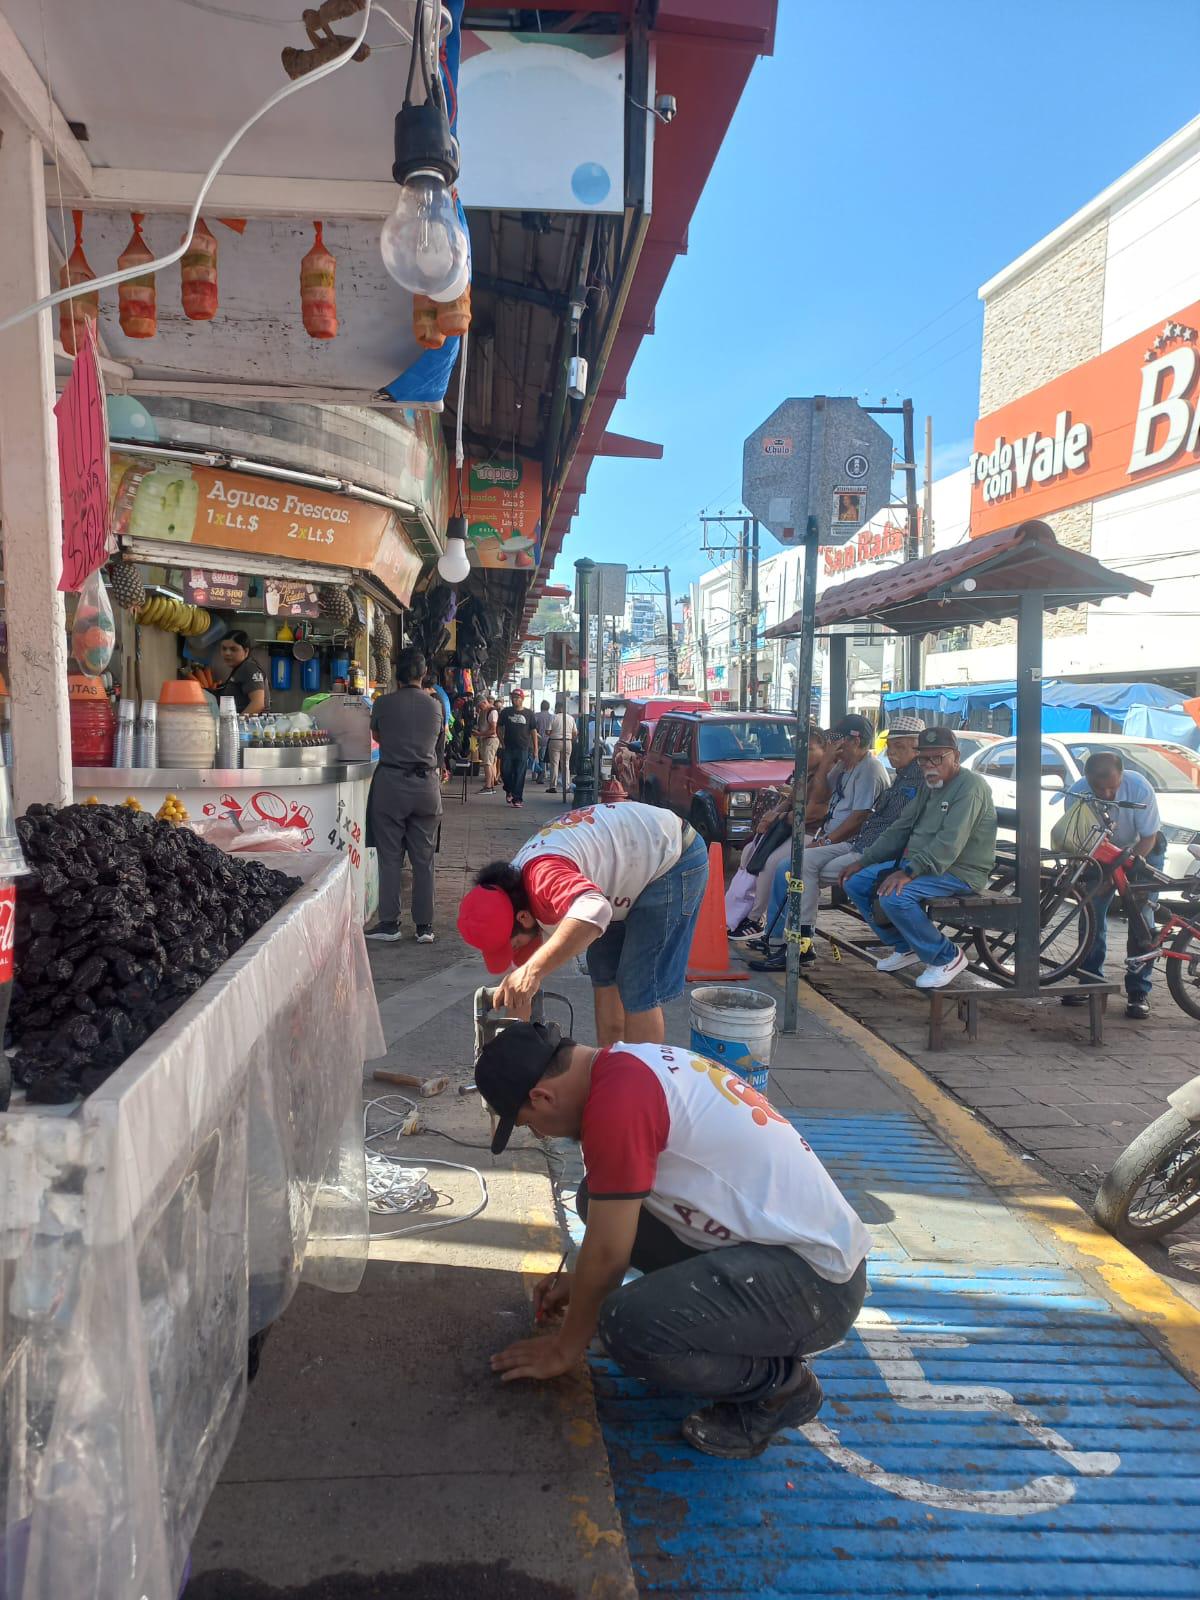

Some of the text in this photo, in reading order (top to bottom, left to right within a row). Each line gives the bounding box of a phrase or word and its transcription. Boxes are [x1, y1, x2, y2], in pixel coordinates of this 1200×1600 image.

[968, 410, 1088, 489] Todo Vale
[207, 480, 351, 525] Aguas Frescas.
[982, 469, 1013, 503] con
